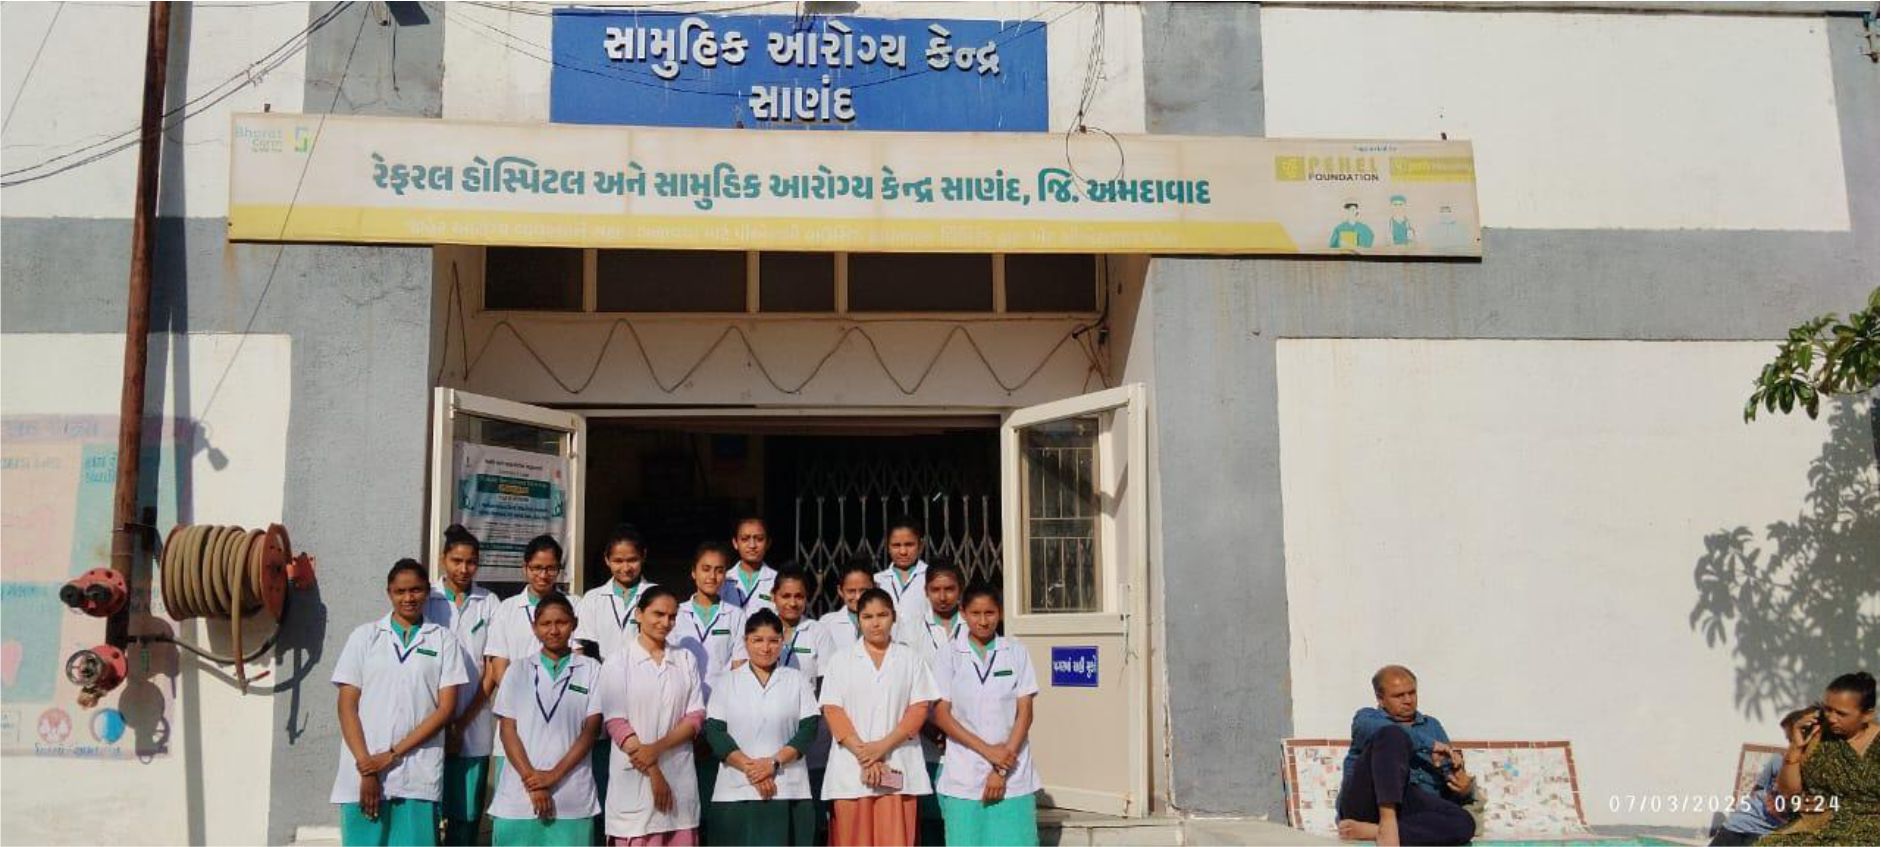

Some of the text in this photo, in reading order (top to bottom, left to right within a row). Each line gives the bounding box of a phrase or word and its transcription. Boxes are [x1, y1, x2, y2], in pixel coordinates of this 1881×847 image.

[604, 17, 1001, 78] સામુહિક આરોગ્ય કેન્દ્ર
[749, 74, 857, 121] સાણંદ
[371, 152, 1211, 210] રેફરલ હોસ્પિટલ અને સામુહિક આરોગ્ય કેન્દ્ર સાણંદ, જિ. અમદાવાદ
[1308, 173, 1379, 181] FOUNDATION
